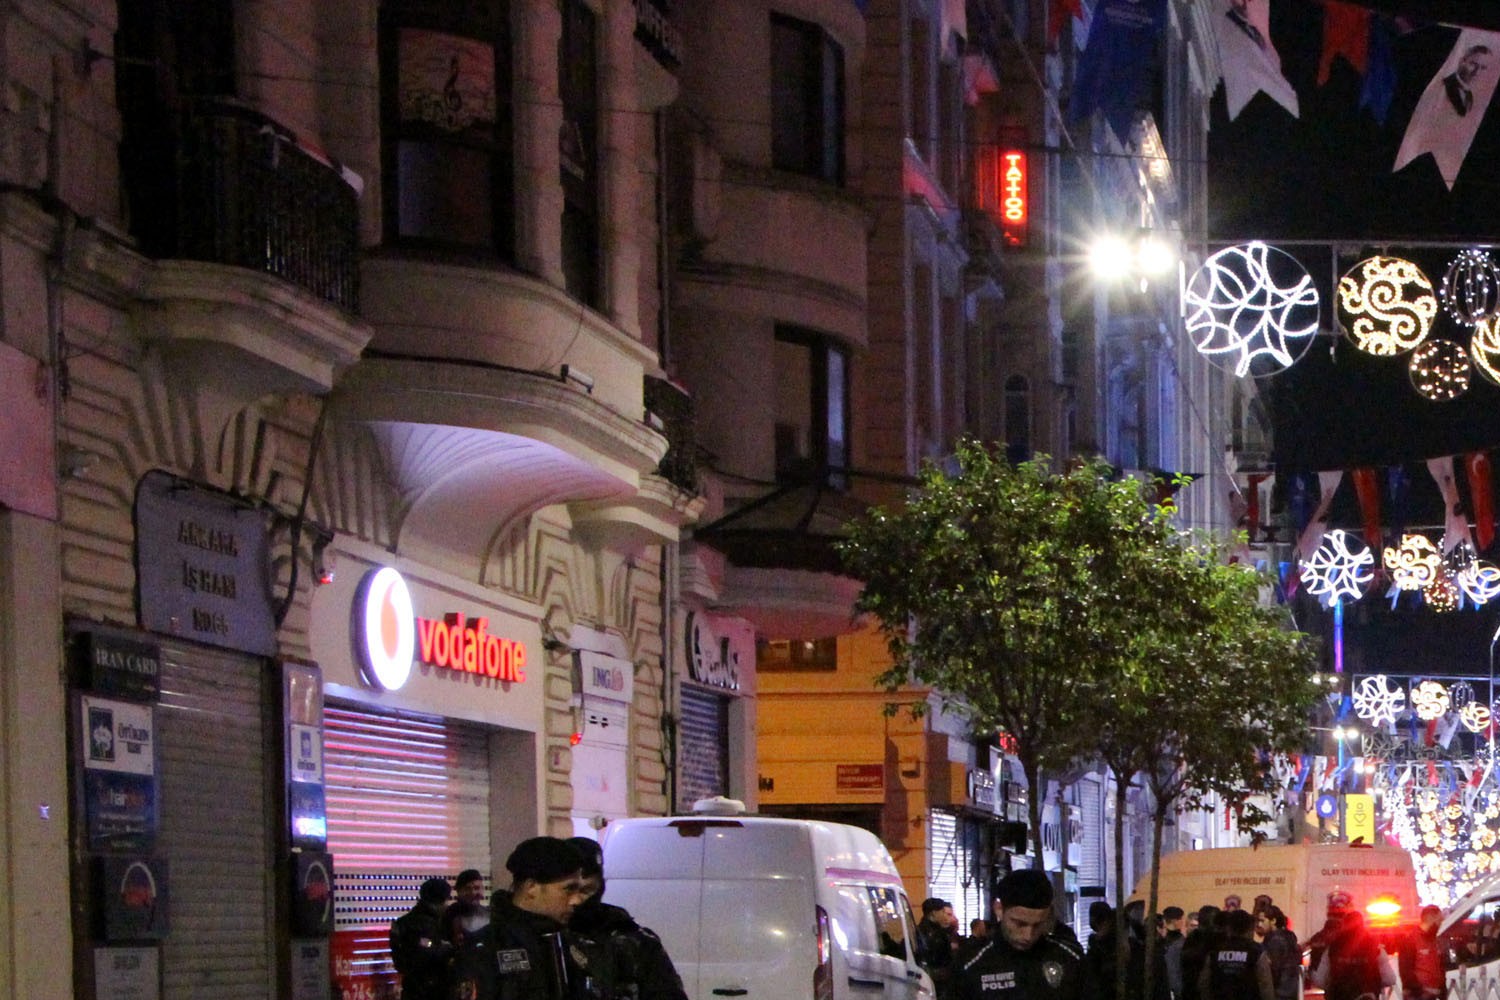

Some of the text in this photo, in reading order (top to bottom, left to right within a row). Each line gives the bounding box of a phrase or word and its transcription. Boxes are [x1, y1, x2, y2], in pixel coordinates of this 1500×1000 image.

[1005, 154, 1023, 220] TATTOO
[417, 611, 527, 683] vodafone
[126, 655, 157, 676] CARD
[592, 665, 612, 690] ING
[1217, 951, 1248, 962] KOM
